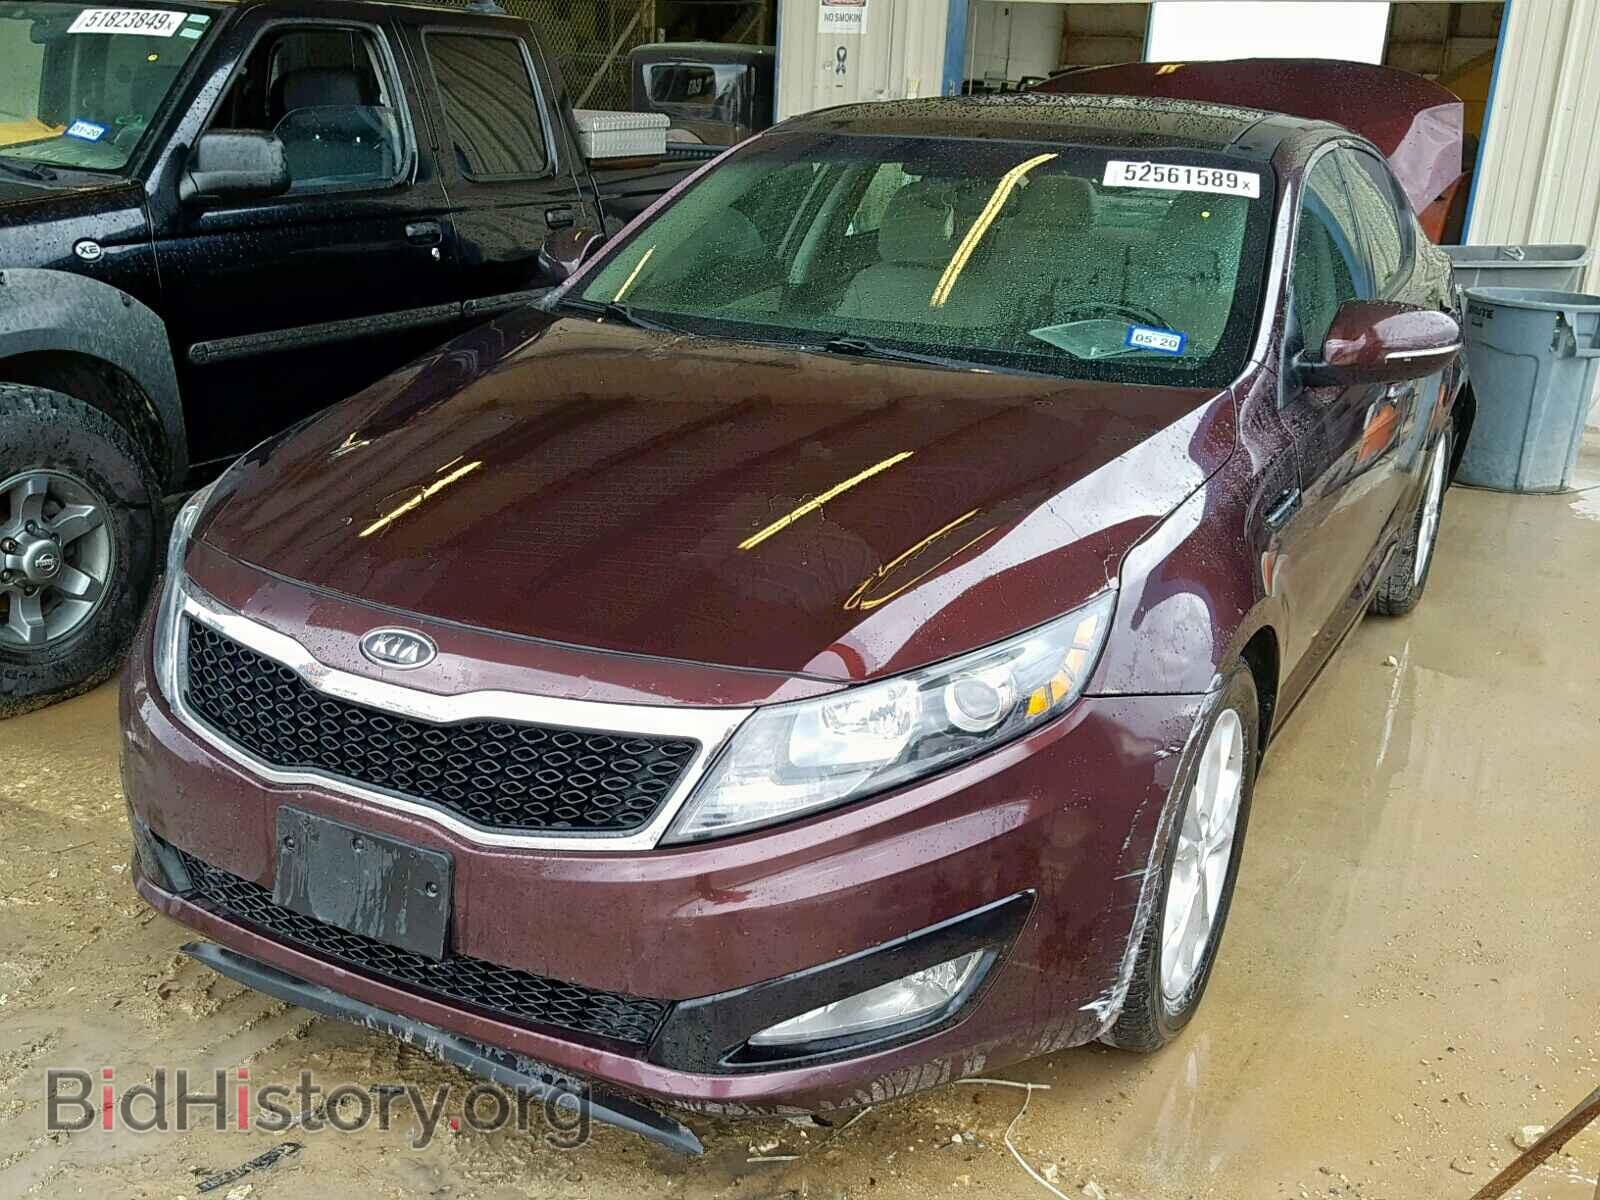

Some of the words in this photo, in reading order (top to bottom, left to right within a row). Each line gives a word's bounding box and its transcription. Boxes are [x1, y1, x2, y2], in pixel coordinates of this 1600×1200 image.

[824, 12, 834, 22] NO
[79, 244, 99, 255] XE
[371, 633, 420, 663] KIA
